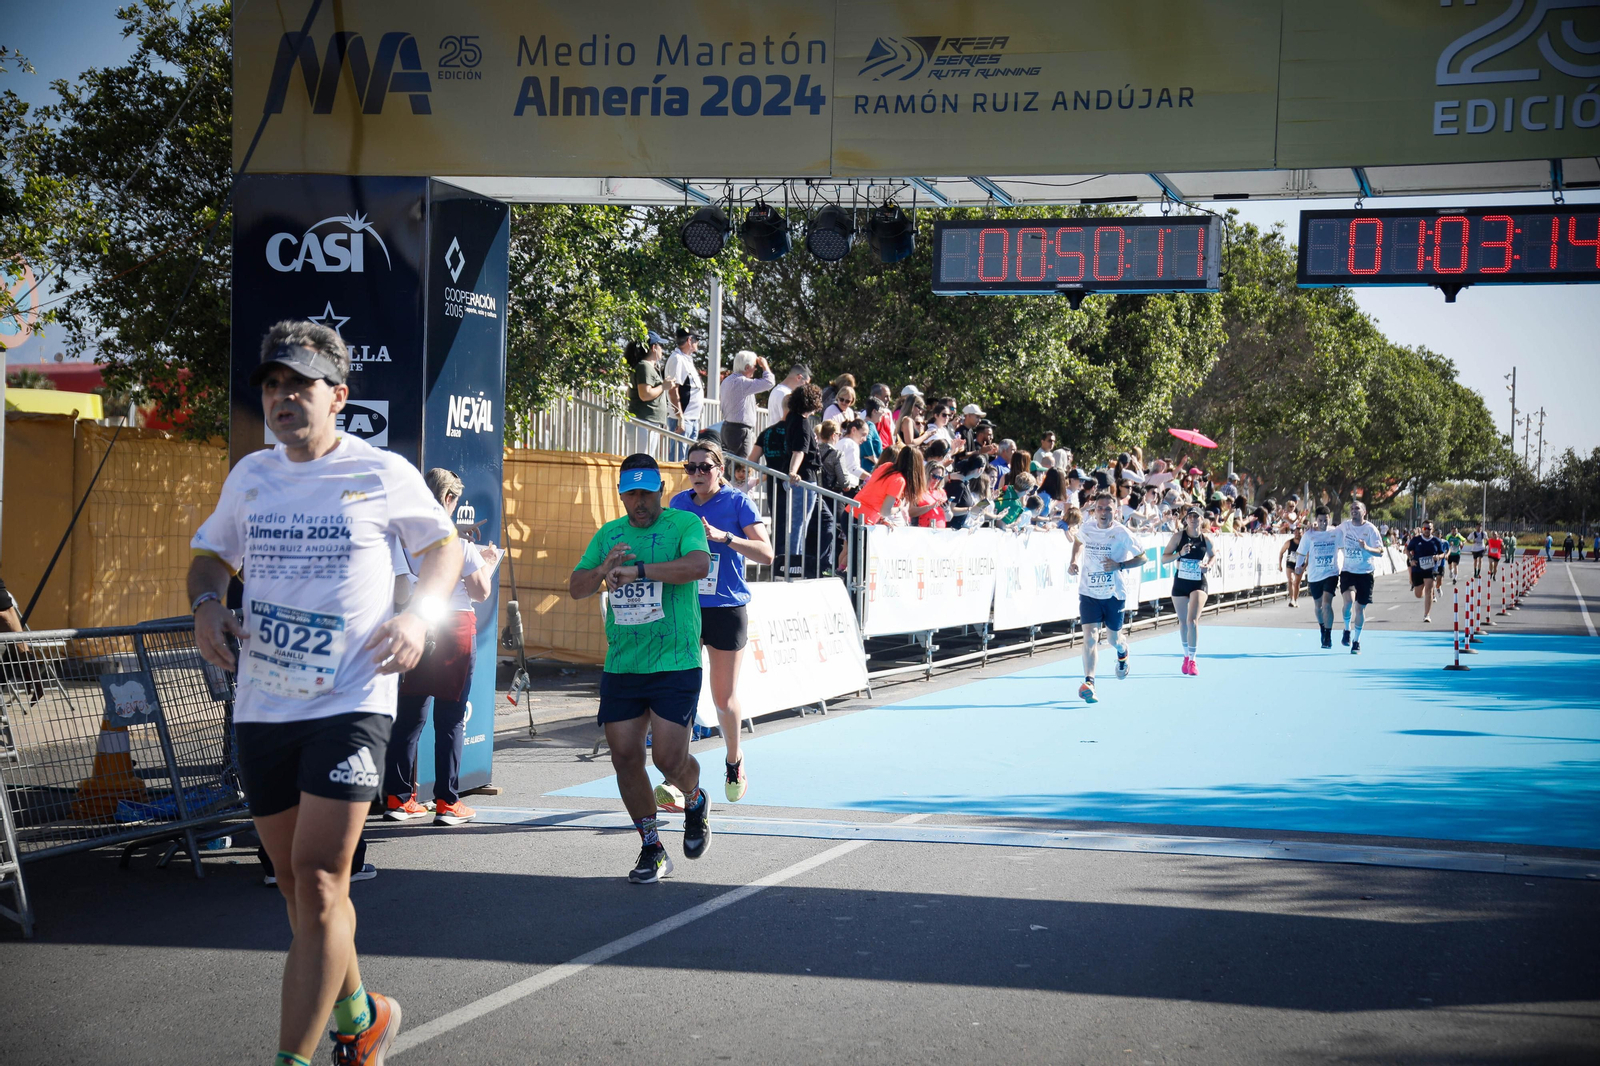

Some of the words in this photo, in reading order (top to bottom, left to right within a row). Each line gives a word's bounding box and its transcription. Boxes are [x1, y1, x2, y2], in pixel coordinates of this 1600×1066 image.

[439, 35, 483, 68] 25
[517, 33, 636, 67] Medio
[656, 32, 827, 67] Maratón
[941, 35, 1010, 53] RFEA
[933, 54, 1003, 67] SERIES
[437, 69, 482, 80] EDICIÓN
[927, 68, 971, 80] RUTA
[974, 66, 1042, 79] RUNNING
[513, 73, 689, 117] Almería
[700, 74, 827, 116] 2024
[854, 88, 959, 115] RAMÓN
[972, 91, 1039, 113] RUIZ
[1051, 84, 1195, 112] ANDÚJAR
[1433, 83, 1600, 136] EDICIÓ
[265, 231, 364, 273] CASI
[444, 286, 497, 312] COOPERACIÓN
[444, 302, 464, 319] 2005
[247, 512, 286, 524] Medio
[291, 512, 353, 525] Maratón
[248, 525, 304, 539] Almería
[306, 526, 352, 539] 2024
[279, 544, 302, 552] RUIZ
[305, 543, 352, 553] ANDÚJAR
[1091, 574, 1112, 584] 5702
[614, 582, 655, 599] 5651
[258, 617, 333, 657] 5022
[328, 769, 380, 787] adidas
